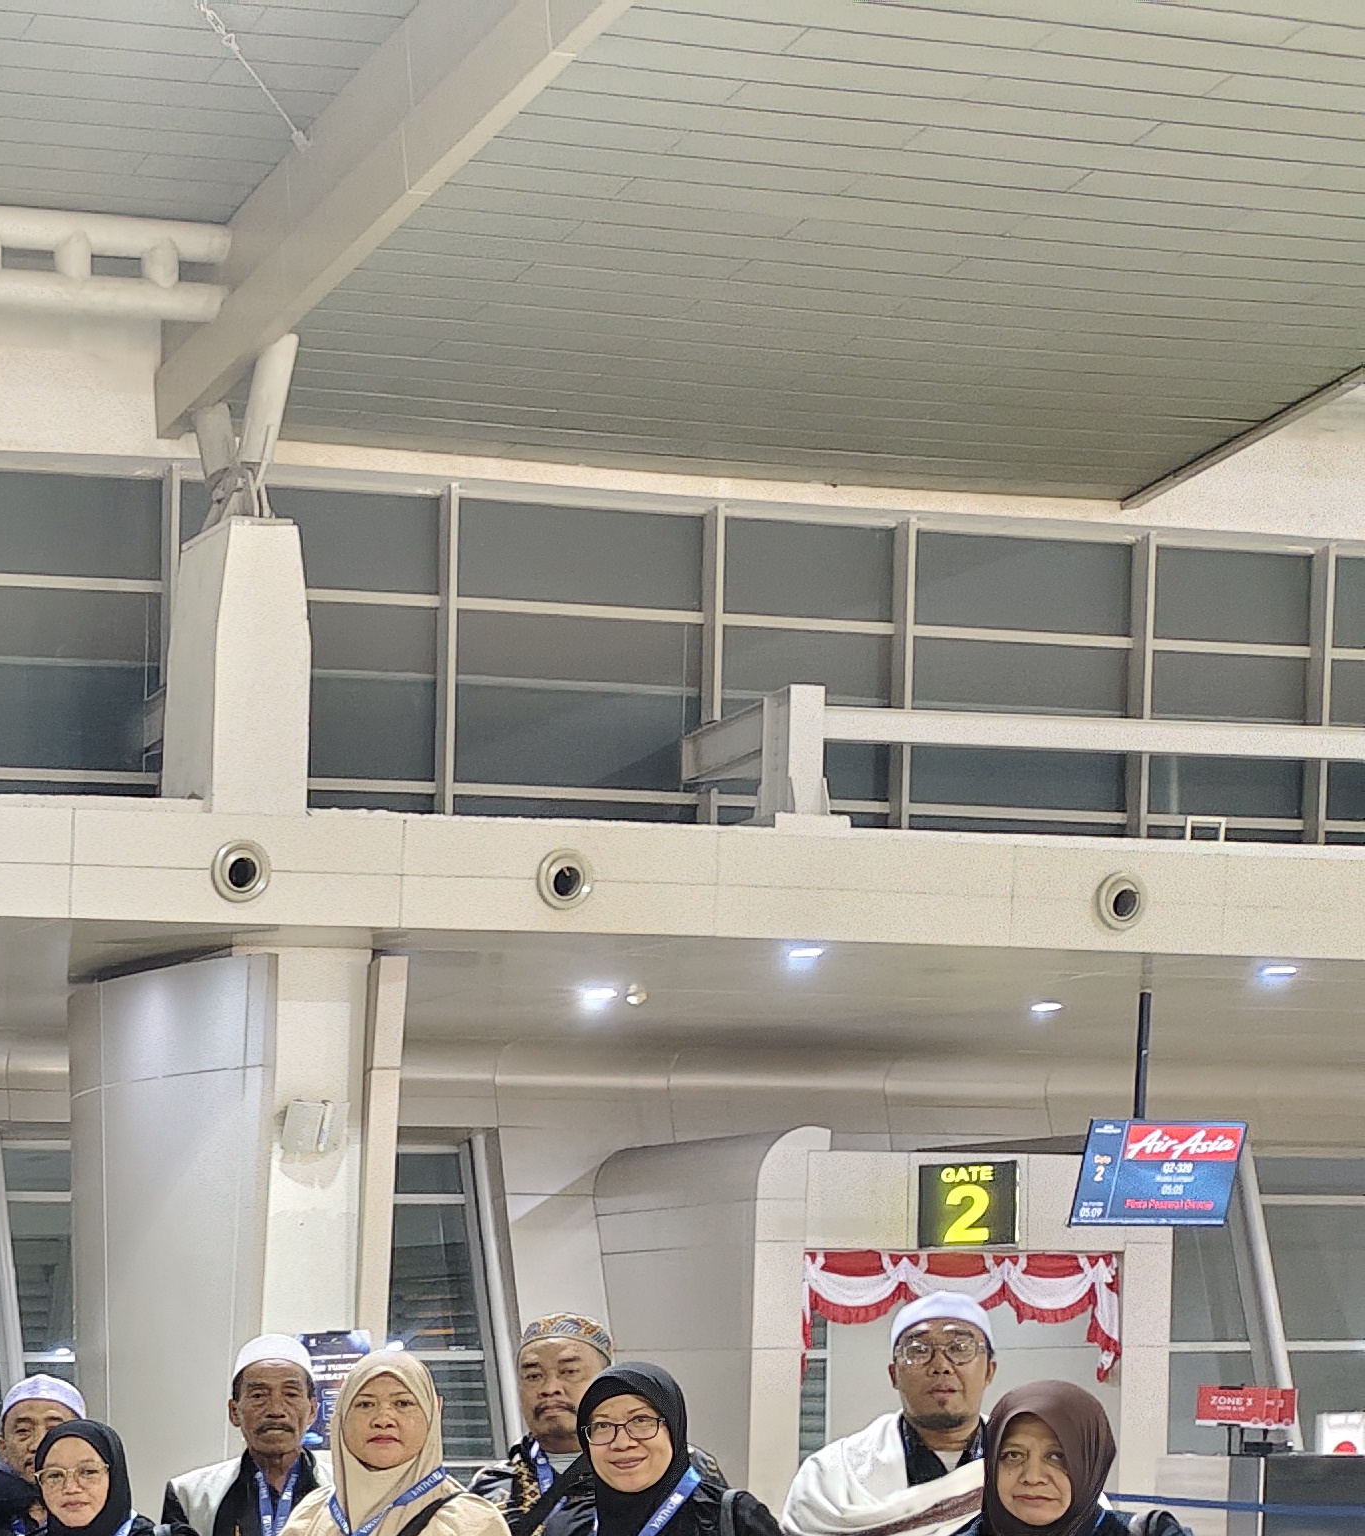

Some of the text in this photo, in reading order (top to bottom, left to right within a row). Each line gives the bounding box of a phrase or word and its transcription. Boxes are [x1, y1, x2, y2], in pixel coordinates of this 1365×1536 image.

[940, 1165, 994, 1183] GATE
[1093, 1165, 1106, 1182] 2
[943, 1183, 990, 1243] 2
[1209, 1395, 1244, 1406] ZONE
[410, 1475, 436, 1496] DALWA
[650, 1502, 677, 1530] DALWA
